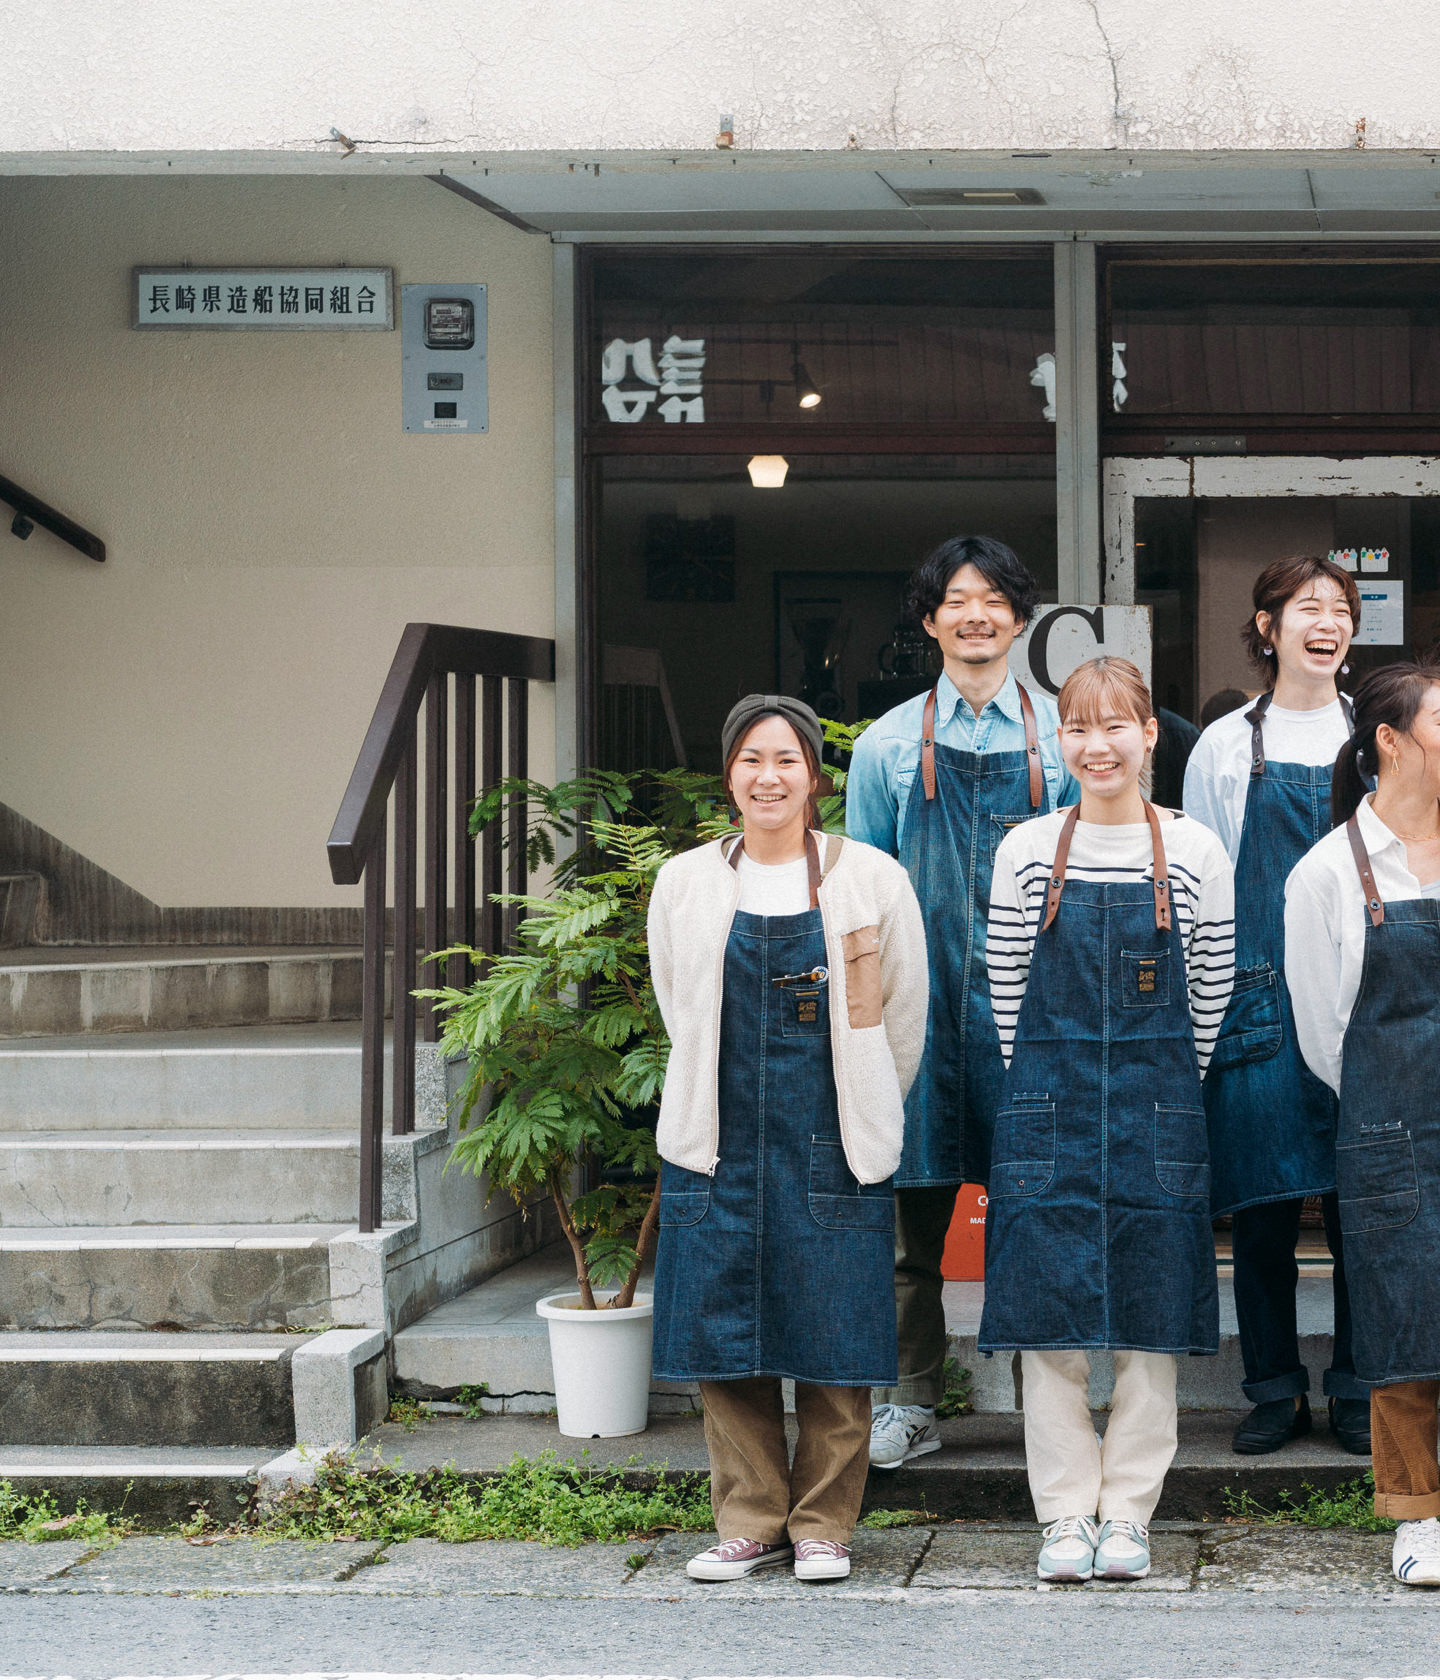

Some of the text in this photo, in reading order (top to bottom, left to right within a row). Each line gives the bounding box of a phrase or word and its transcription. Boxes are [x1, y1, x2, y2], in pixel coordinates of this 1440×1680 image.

[148, 285, 377, 314] 長崎県造船協同組合
[977, 1195, 989, 1207] C
